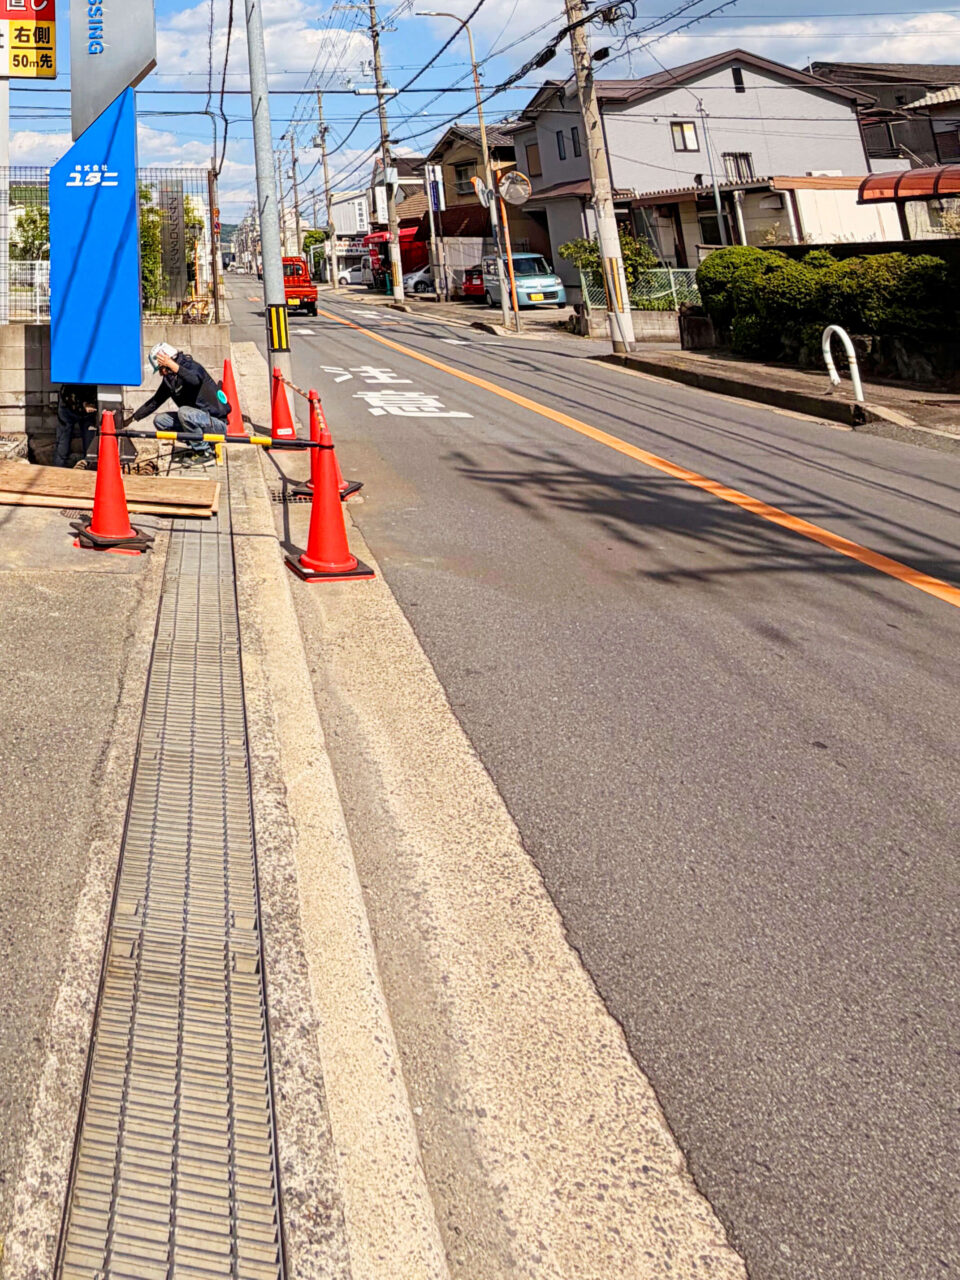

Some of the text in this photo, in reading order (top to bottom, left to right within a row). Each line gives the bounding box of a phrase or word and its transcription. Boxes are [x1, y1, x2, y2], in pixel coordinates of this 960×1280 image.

[14, 25, 51, 44] 右側
[12, 53, 53, 69] 50m先
[65, 172, 119, 187] ユタニ
